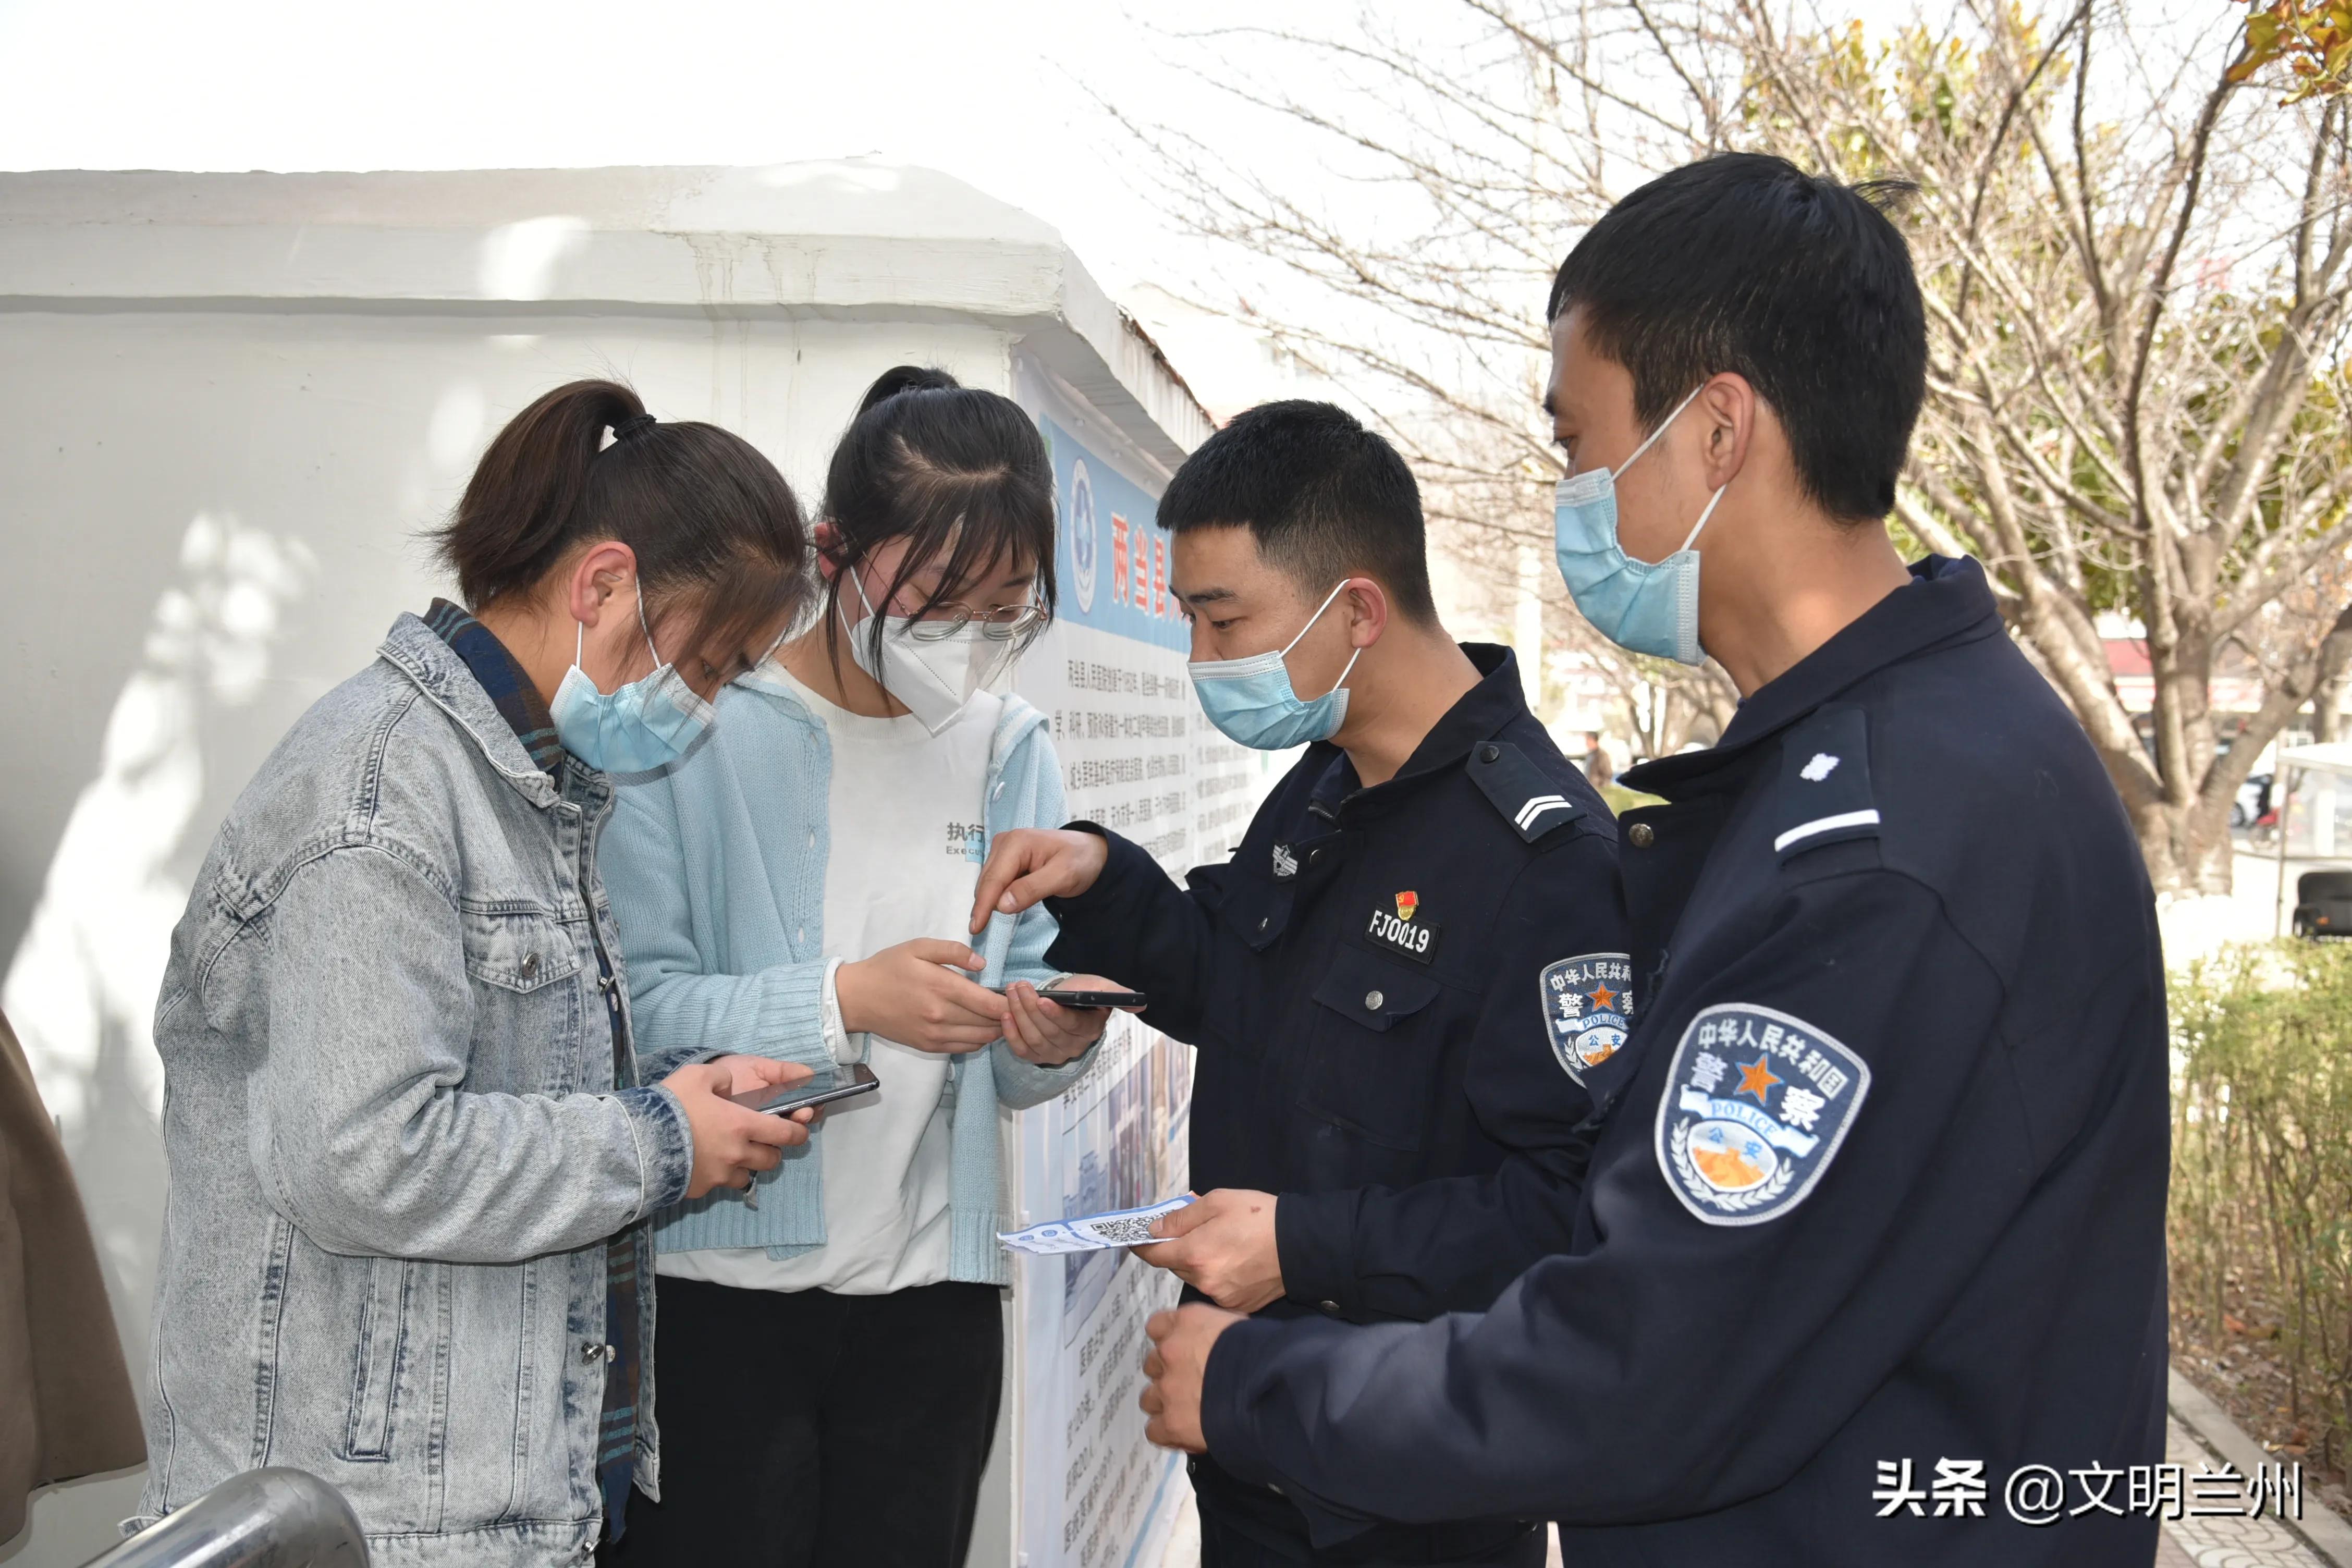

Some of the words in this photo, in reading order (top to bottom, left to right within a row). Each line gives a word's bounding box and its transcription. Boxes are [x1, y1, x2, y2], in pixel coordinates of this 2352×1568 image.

[946, 845, 983, 856] Execu
[1559, 993, 1583, 1018] 警
[1583, 1016, 1624, 1029] POLICE
[1690, 1051, 1728, 1092] 警
[1698, 1018, 1849, 1101] 中华人民共和国
[1711, 1102, 1778, 1135] POLICE
